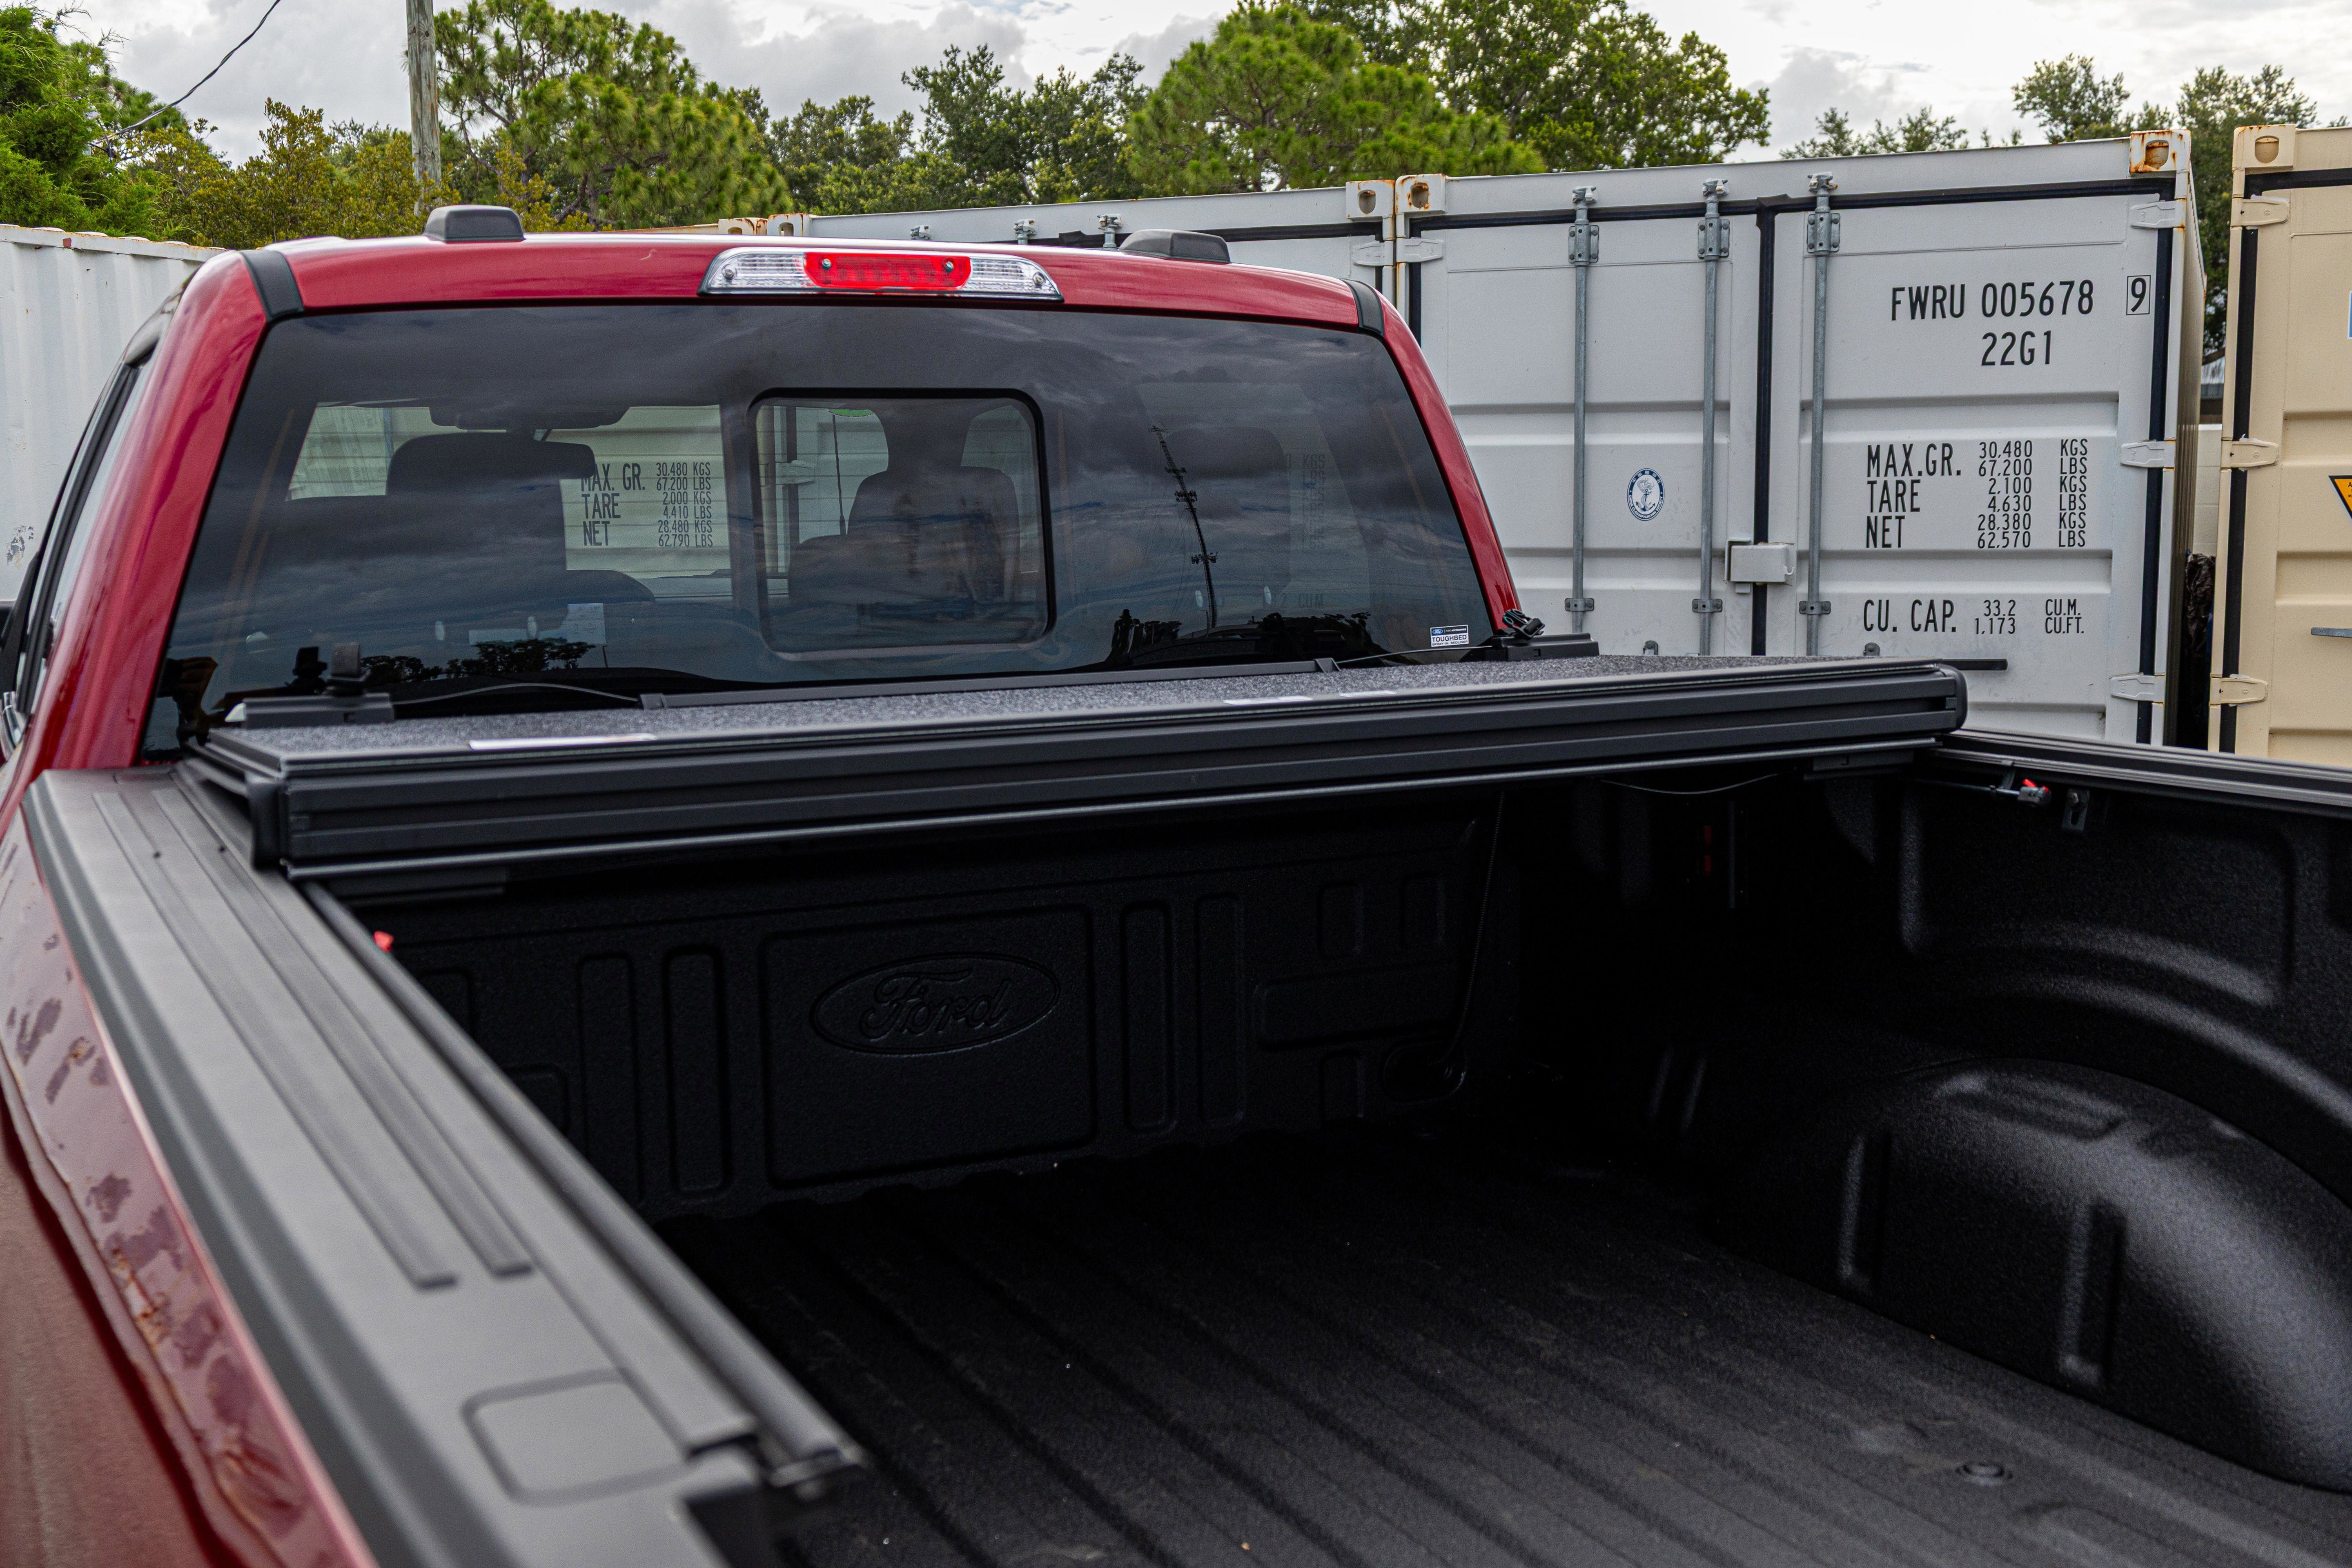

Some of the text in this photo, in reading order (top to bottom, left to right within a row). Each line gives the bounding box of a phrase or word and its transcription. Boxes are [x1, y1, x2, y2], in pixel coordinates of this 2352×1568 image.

[1891, 277, 2147, 321] FWRU 005678 9
[1981, 330, 2051, 366] 22G1
[1979, 440, 2032, 459] 30,480
[2060, 438, 2088, 456] KGS
[622, 463, 645, 490] GR.
[656, 462, 688, 476] 30,480
[693, 462, 710, 476] KGS
[1978, 457, 2087, 477] 67,200 LBS
[657, 477, 711, 491] 67,200 LBS
[1867, 475, 2087, 513] TARE 2,100 KGS
[581, 491, 711, 519] TARE 2,000 KGS
[663, 506, 712, 519] 4,410 LBS
[1988, 493, 2086, 512] 4,630 LBS
[583, 519, 712, 546] NET 28,480 KGS
[659, 534, 713, 547] 62,790 LBS
[1866, 512, 2086, 548] NET 28,380 KGS
[1978, 530, 2085, 549] 62,570 LBS
[1863, 599, 2080, 633] CU. CAP. 33.2 CU.M.
[1975, 617, 2084, 635] 1,173 CU.FT.
[858, 967, 1011, 1042] Ford
